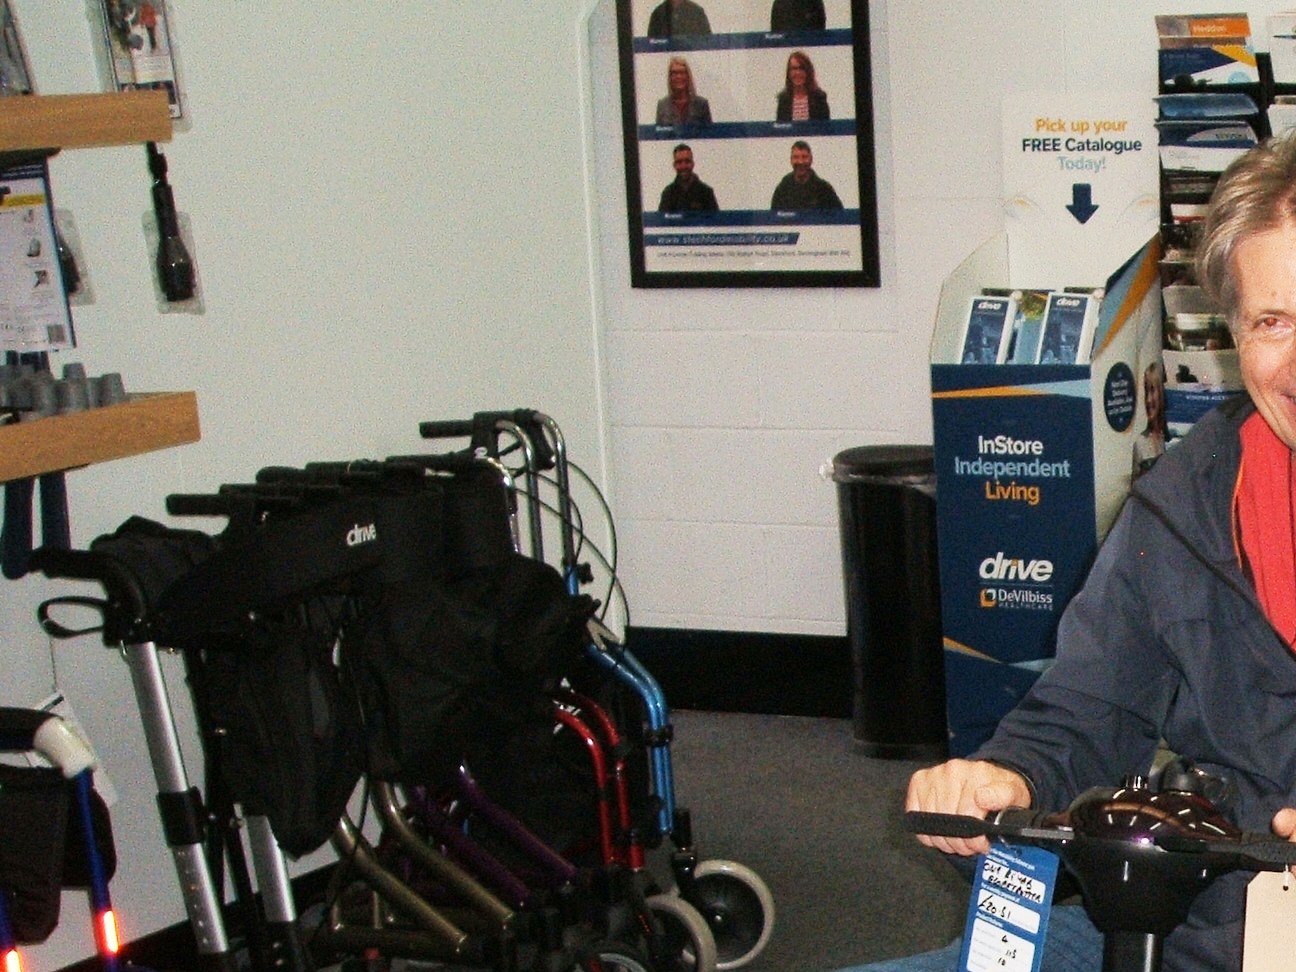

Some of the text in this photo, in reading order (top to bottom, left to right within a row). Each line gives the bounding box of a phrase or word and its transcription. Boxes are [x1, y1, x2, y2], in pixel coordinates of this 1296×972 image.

[1035, 118, 1128, 135] Pick up your
[1022, 137, 1143, 155] FREE Catalogue
[1057, 156, 1107, 173] Today!
[978, 435, 1044, 455] InStore
[955, 456, 1071, 479] Independent
[985, 481, 1040, 505] Living
[979, 552, 1053, 582] drive
[998, 589, 1053, 603] DeVilbiss
